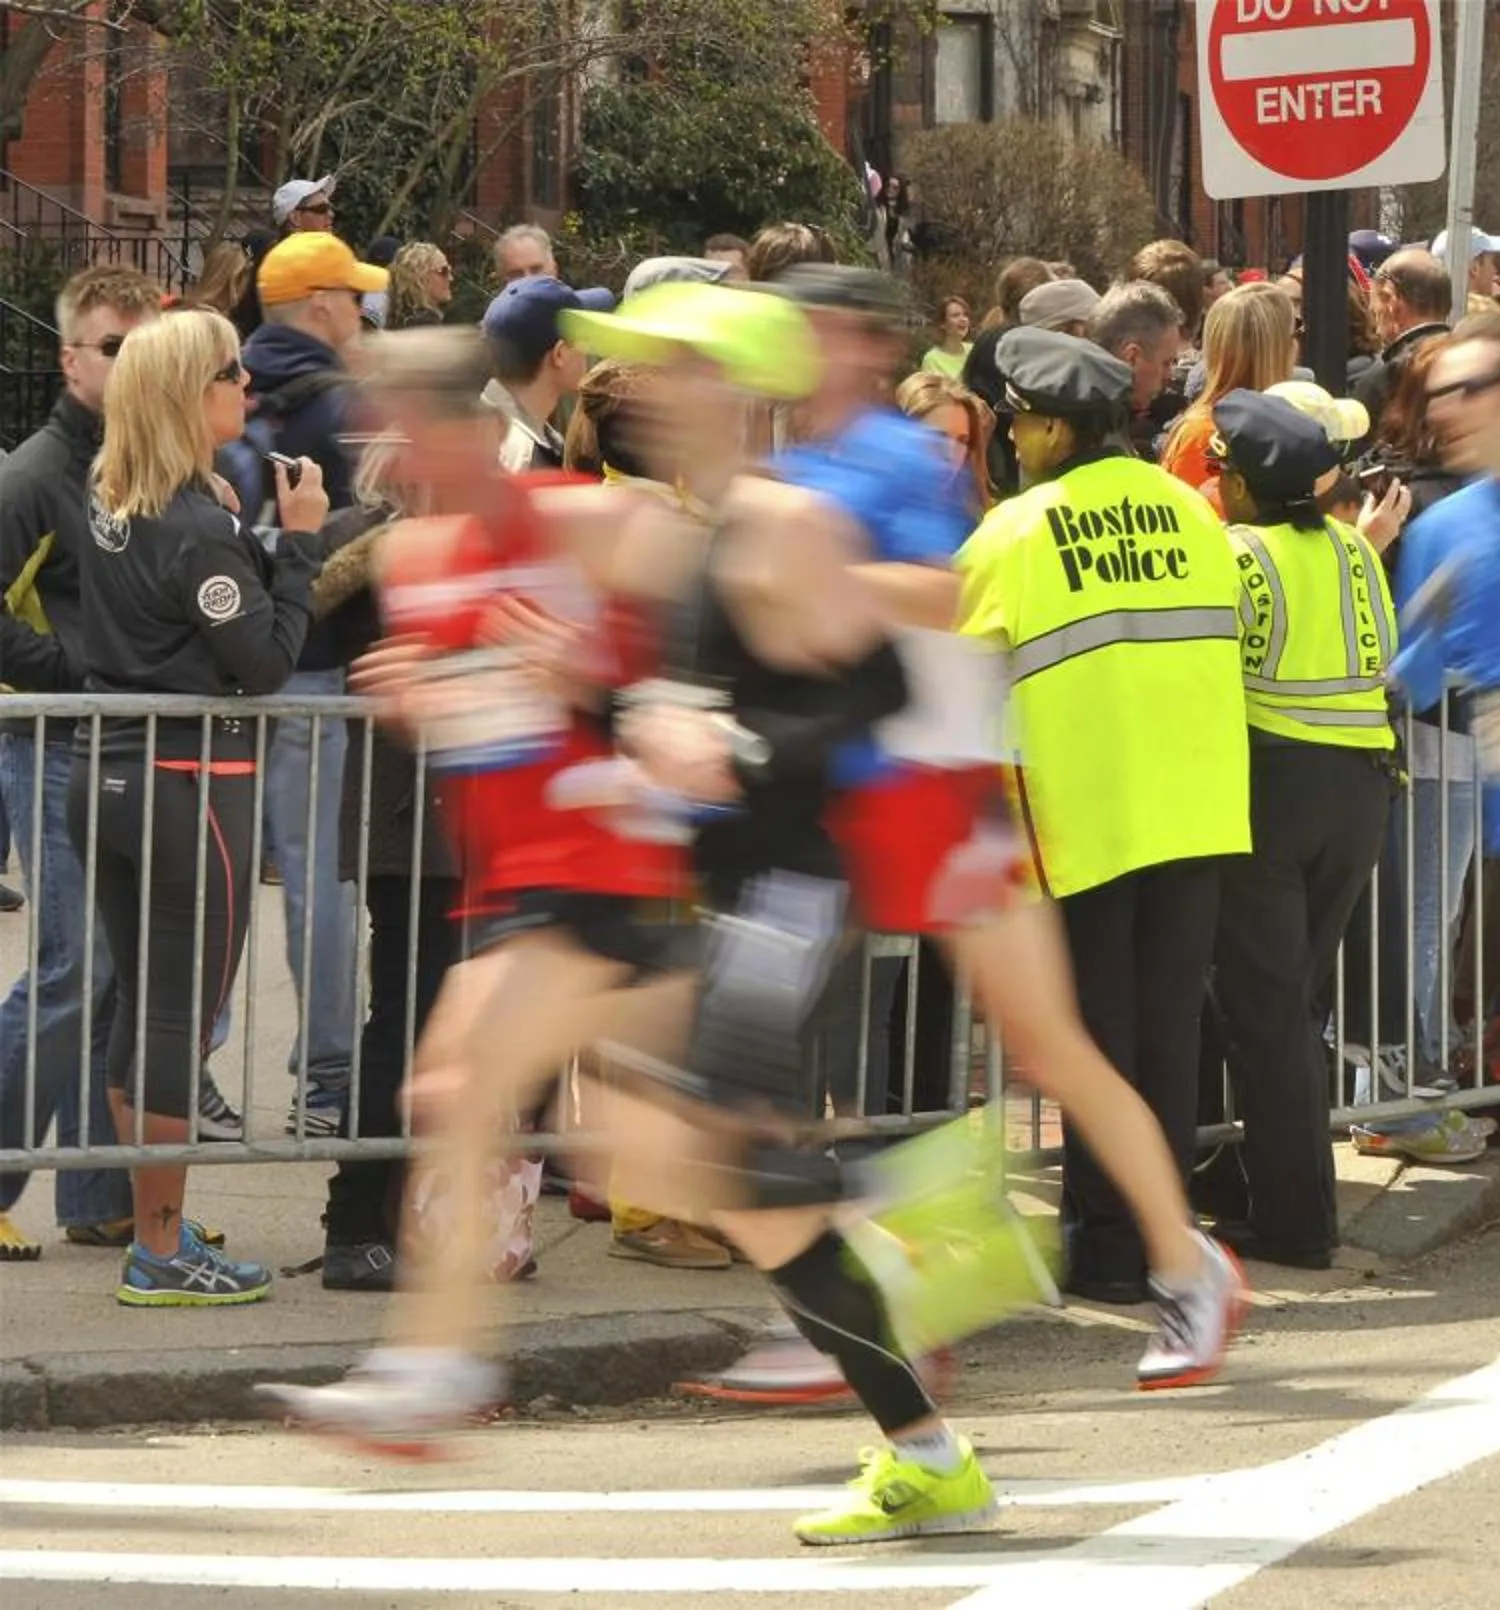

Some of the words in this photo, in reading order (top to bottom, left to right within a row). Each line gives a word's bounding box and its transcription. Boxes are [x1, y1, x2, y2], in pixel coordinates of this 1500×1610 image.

[1237, 0, 1291, 23] DO
[1256, 79, 1382, 124] ENTER
[1045, 496, 1179, 547] Boston
[1059, 538, 1189, 592] Police
[1345, 543, 1379, 671] POLICE
